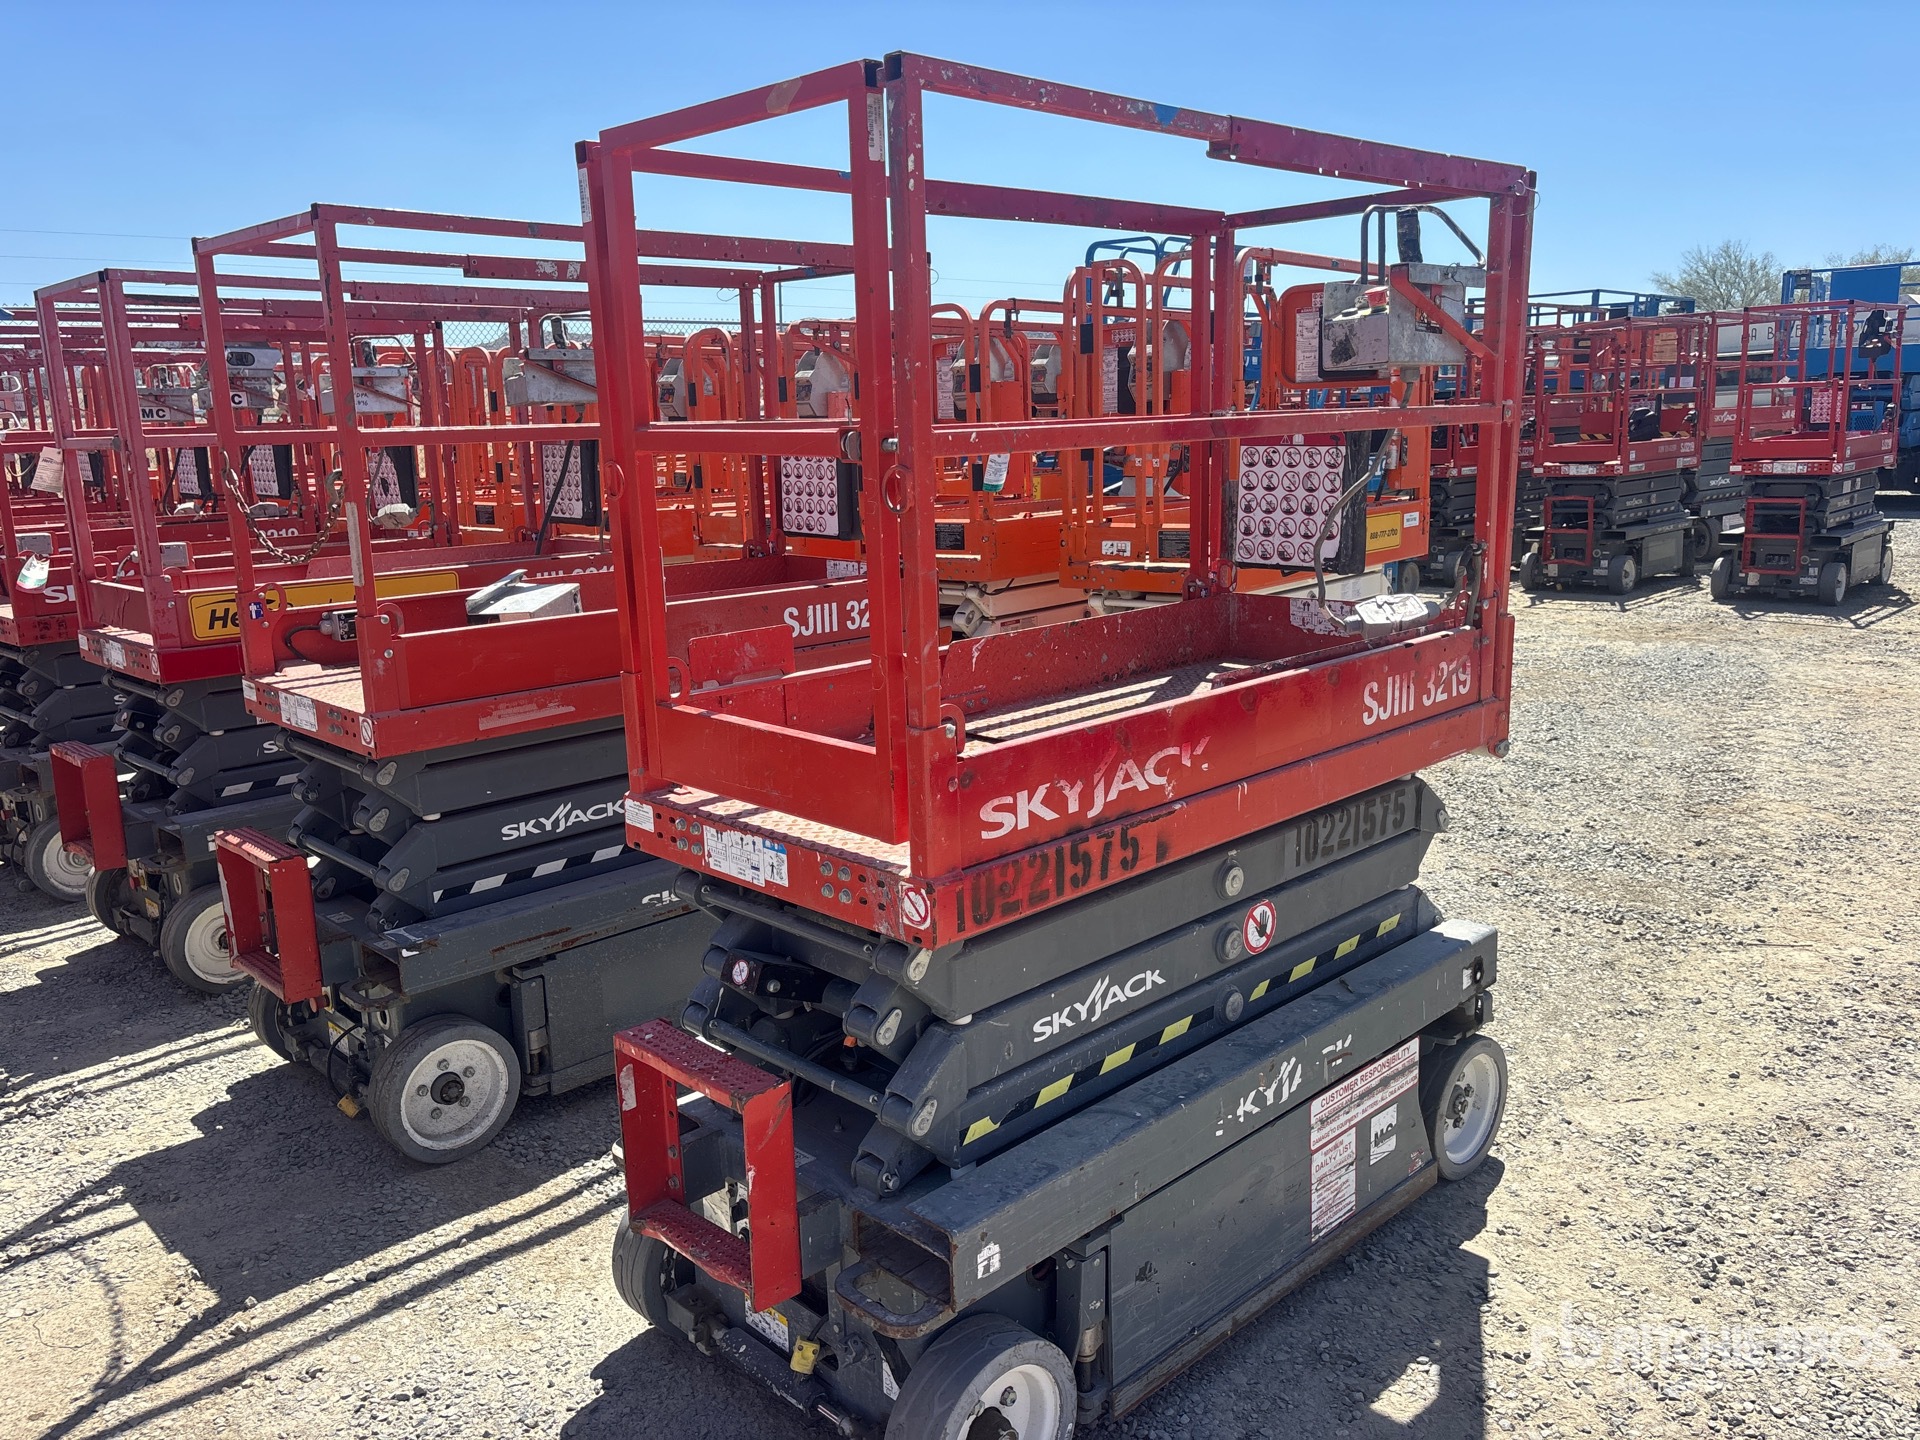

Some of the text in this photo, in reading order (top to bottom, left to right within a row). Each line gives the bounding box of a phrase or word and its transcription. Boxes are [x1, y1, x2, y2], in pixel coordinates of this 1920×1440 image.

[1363, 654, 1472, 726] SJIII 3219
[501, 800, 626, 841] SKYJACK
[1295, 788, 1406, 868] 10221575
[1033, 969, 1166, 1043] SKYJACK
[1320, 1077, 1359, 1109] CUSTOMER
[1359, 1045, 1411, 1084] RESPONSIBILITY
[1314, 1155, 1334, 1174] DAILY
[1338, 1141, 1353, 1157] LIST
